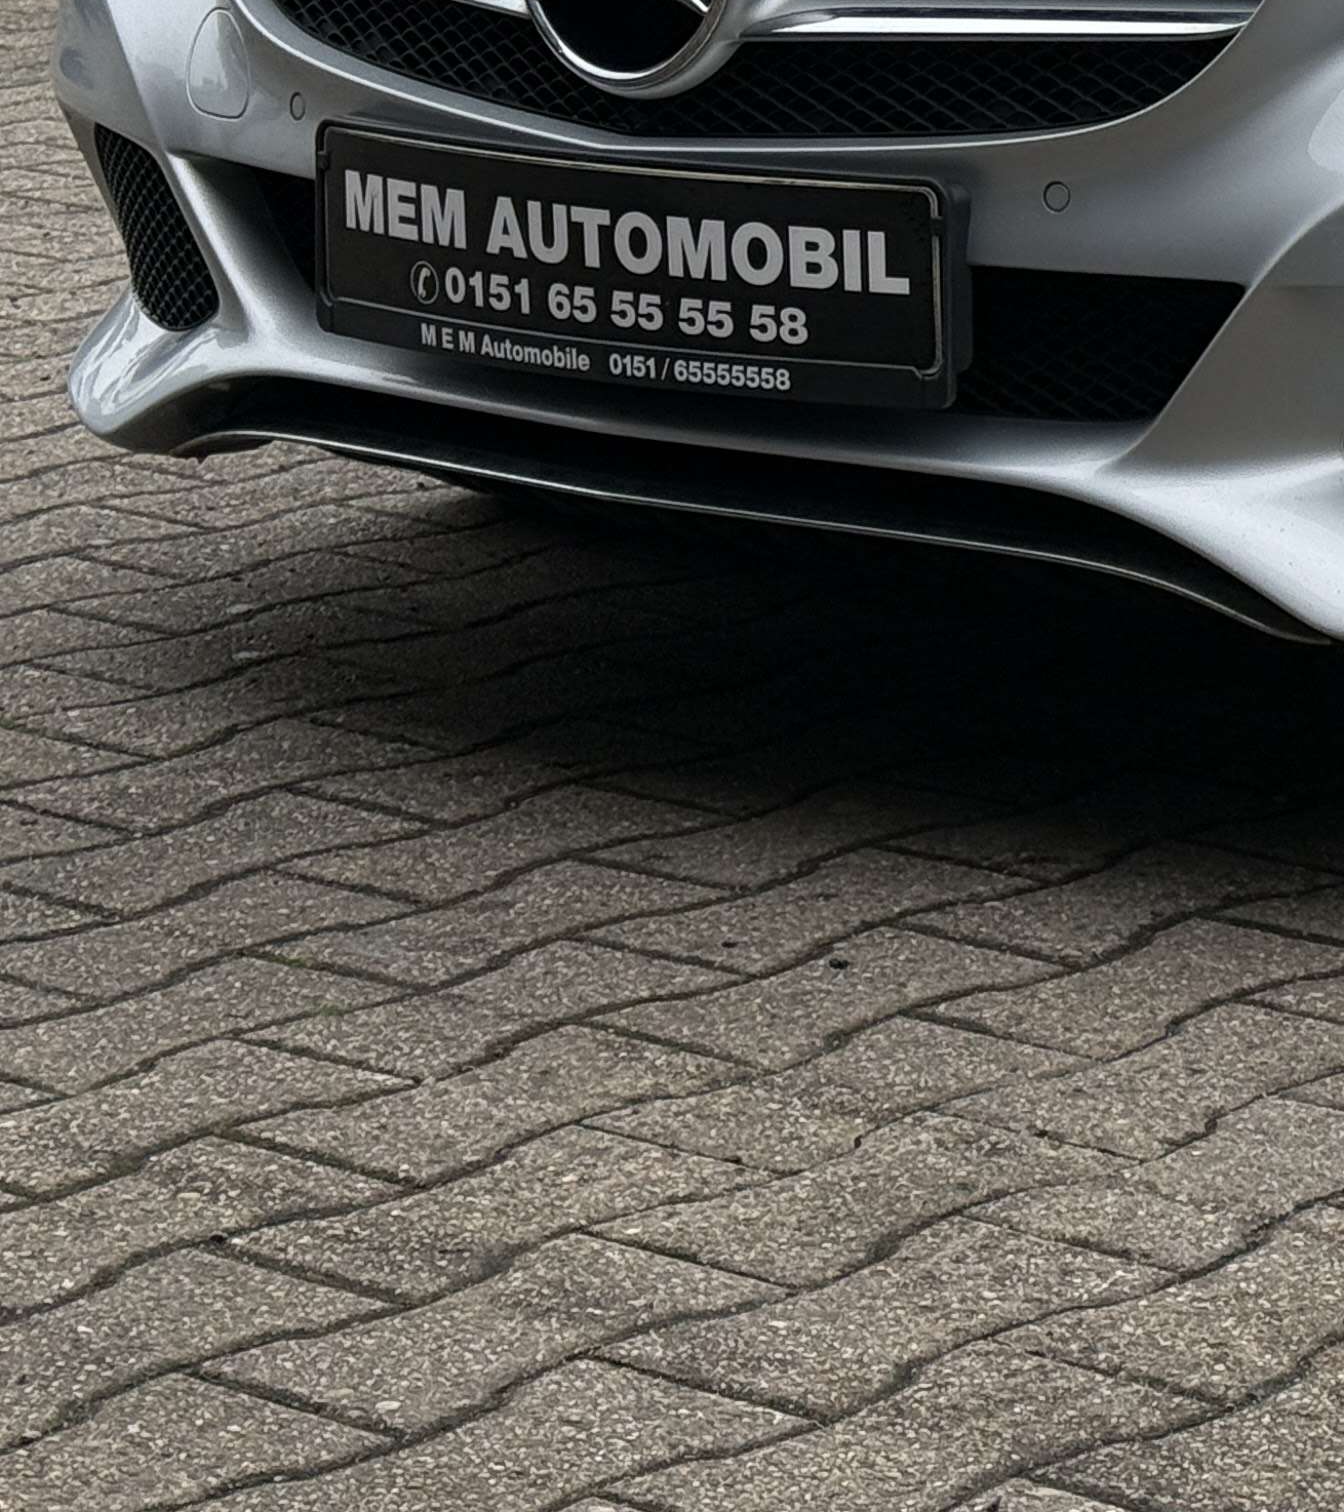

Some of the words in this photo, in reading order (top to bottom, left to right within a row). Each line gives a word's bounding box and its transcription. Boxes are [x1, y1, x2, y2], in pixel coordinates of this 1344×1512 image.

[344, 169, 467, 250] MEM
[486, 195, 911, 295] AUTOMOBIL
[445, 267, 530, 315] 0151
[548, 283, 597, 323] 65
[610, 290, 664, 331] 55
[678, 297, 734, 338] 55
[750, 304, 808, 345] 58
[480, 334, 591, 371] Automobile
